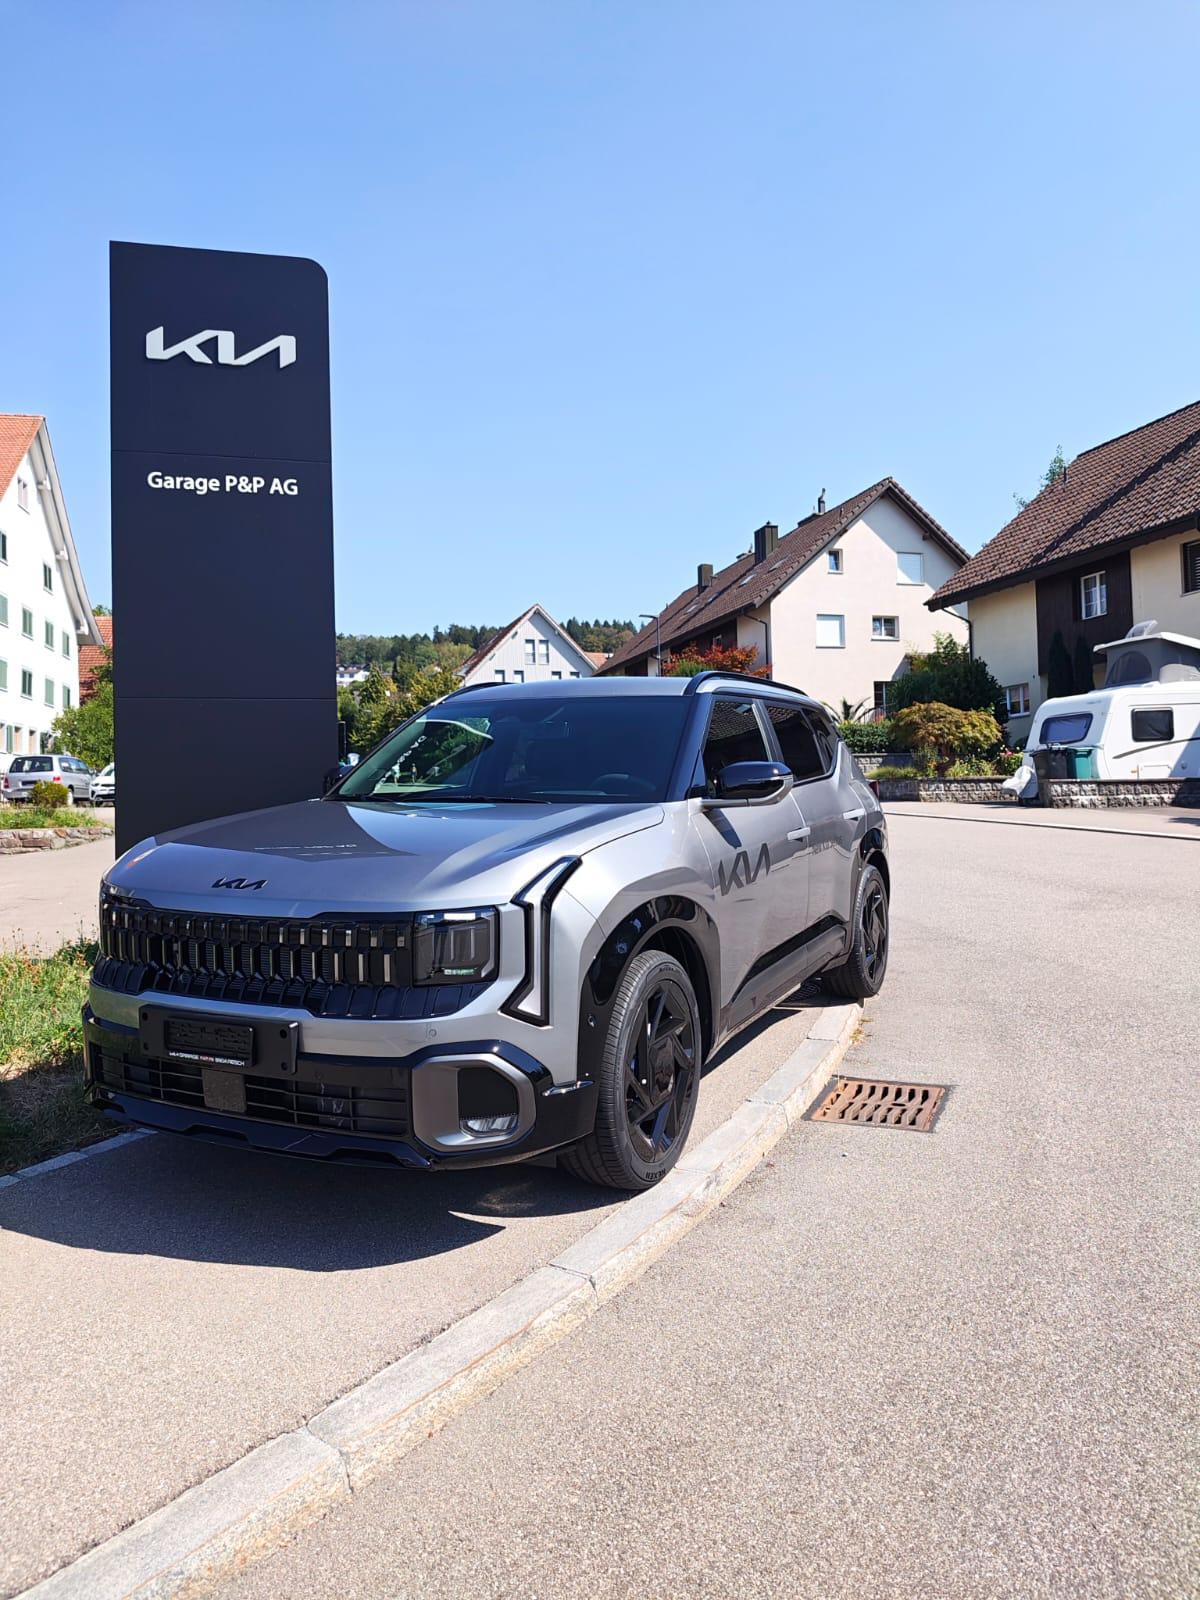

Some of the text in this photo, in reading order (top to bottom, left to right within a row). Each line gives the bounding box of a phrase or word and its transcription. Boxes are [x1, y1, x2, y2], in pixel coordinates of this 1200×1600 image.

[146, 326, 297, 369] KIA
[147, 471, 299, 496] Garage P&P AG
[211, 876, 269, 891] KIA
[717, 842, 771, 897] KIA
